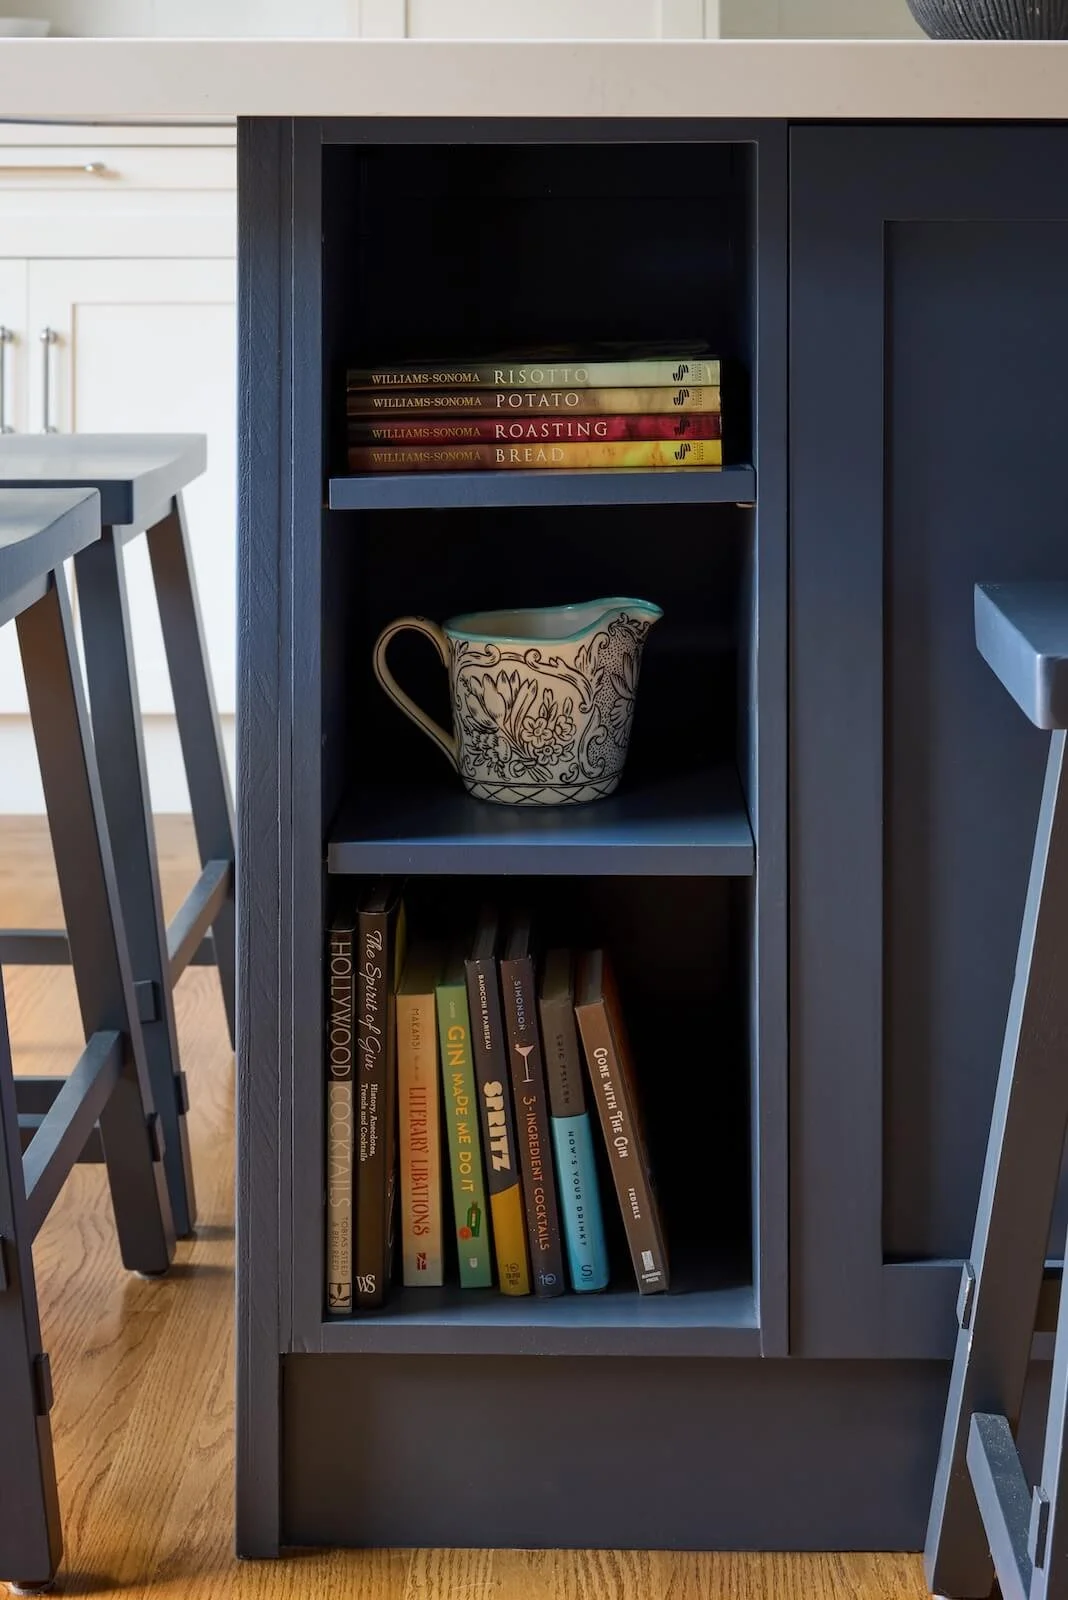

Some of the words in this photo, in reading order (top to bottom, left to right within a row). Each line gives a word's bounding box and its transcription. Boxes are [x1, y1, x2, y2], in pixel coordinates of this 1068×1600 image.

[372, 373, 481, 385] WILLIAMS-SONOMA
[494, 368, 589, 385] RISOTTO
[373, 397, 482, 408] WILLIAMS-SONOMA
[496, 392, 580, 408] POTATO
[372, 428, 481, 439] WILLIAMS-SONOMA
[495, 422, 608, 439] ROASTING
[373, 452, 482, 463] WILLIAMS-SONOMA
[496, 447, 565, 463] BREAD
[365, 929, 383, 960] The
[359, 961, 382, 1012] Spirit
[478, 974, 487, 1009] BAIOCCHI
[330, 941, 352, 1077] HOLLYWOOD
[513, 979, 526, 1031] SIMONSON
[358, 1014, 381, 1035] of
[482, 1015, 492, 1050] PARISEAU
[357, 1035, 381, 1071] Gin
[446, 1024, 466, 1066] GIN
[593, 1047, 610, 1079] GONE
[360, 1083, 369, 1110] Trends
[368, 1083, 378, 1114] History,
[451, 1072, 469, 1116] MADE
[602, 1081, 617, 1110] WITH
[360, 1111, 368, 1126] and
[409, 1087, 429, 1153] LITERARY
[457, 1122, 471, 1144] ME
[483, 1080, 511, 1172] SPRITZ
[609, 1110, 624, 1134] THE
[329, 1086, 351, 1208] COCKTAILS
[360, 1126, 368, 1162] Cocktails
[368, 1115, 378, 1157] Anecdotes,
[568, 1131, 578, 1165] HOW'S
[613, 1136, 629, 1158] GIN
[459, 1151, 472, 1175] DO
[522, 1095, 543, 1181] 3-INGREDIENT
[533, 1187, 550, 1251] COCKTAILS
[410, 1160, 430, 1236] LIBATIONS
[461, 1179, 474, 1193] IT
[572, 1171, 582, 1200] YOUR
[628, 1187, 641, 1220] FEDERLE
[576, 1206, 587, 1247] DRINK?
